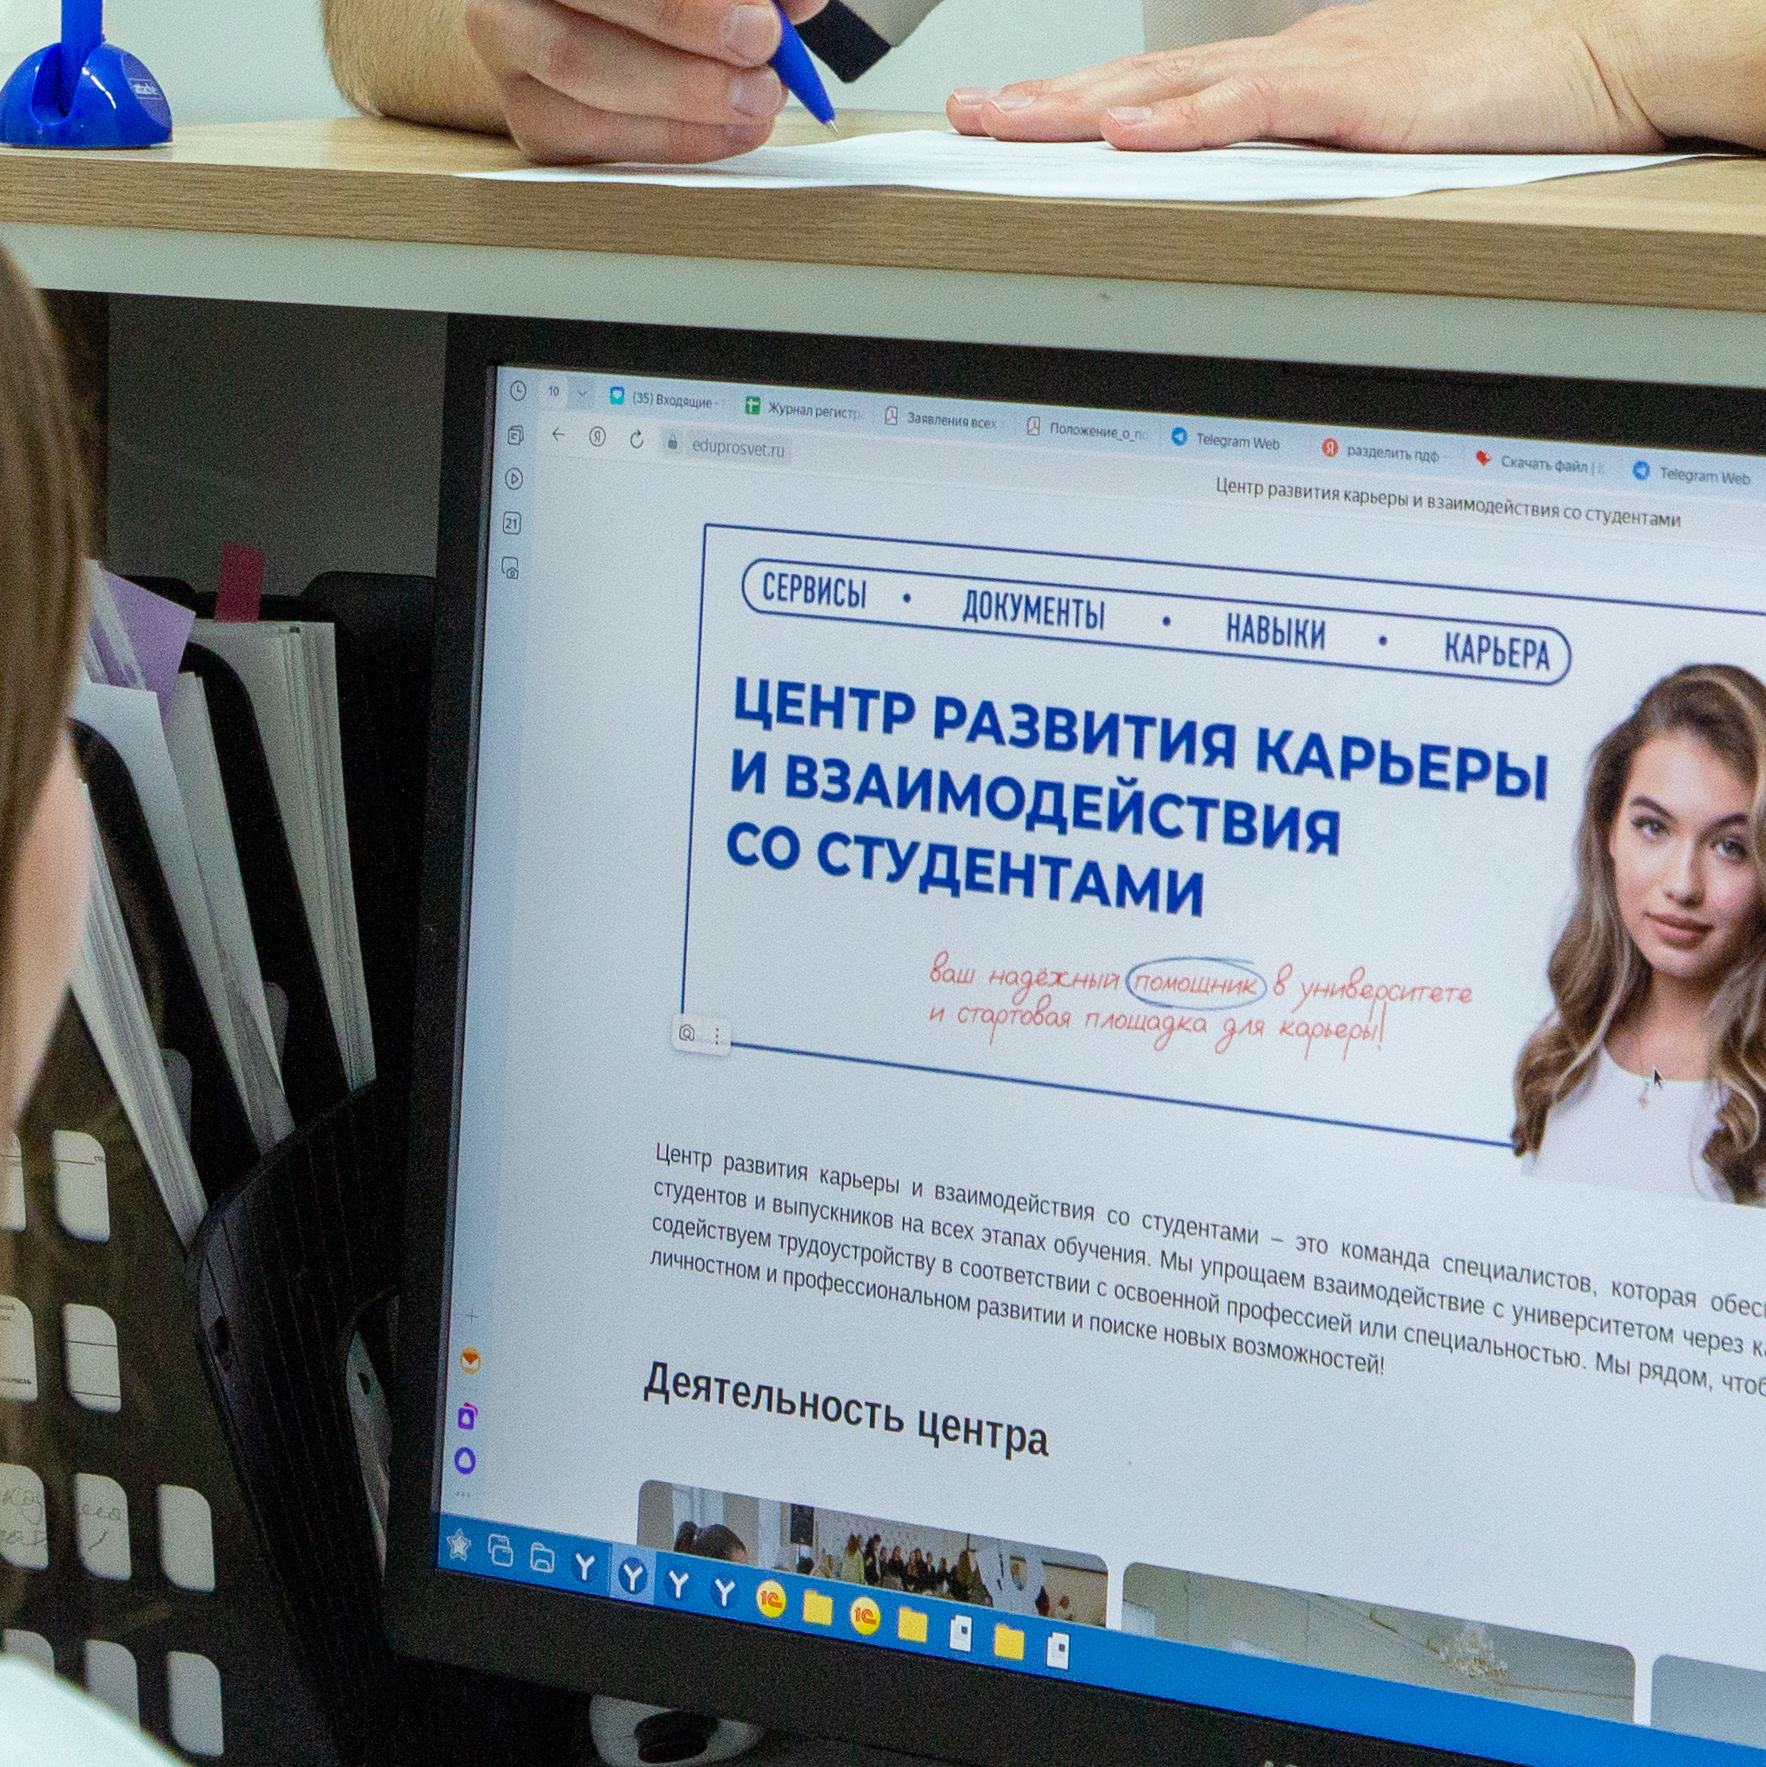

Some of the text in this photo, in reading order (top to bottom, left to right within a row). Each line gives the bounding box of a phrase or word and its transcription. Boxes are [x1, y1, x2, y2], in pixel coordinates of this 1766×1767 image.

[548, 385, 560, 397] 10
[632, 391, 713, 410] (35) Входящие
[768, 401, 817, 419] Журнал
[907, 411, 969, 428] Заявления
[691, 438, 785, 459] eduprosvet.ru
[1195, 431, 1281, 451] Telegram Web
[1346, 443, 1440, 464] разделить пдф
[1499, 454, 1592, 476] Скачать файл
[1659, 466, 1752, 486] Telegram Web
[1216, 476, 1681, 527] Центр развития карьеры и взаимодействия со студентами
[505, 518, 518, 530] 21
[763, 571, 867, 609] СЕРВИСЫ
[962, 589, 1105, 630] ДОКУМЕНТЫ
[1226, 612, 1326, 650] НАВЫКИ
[1445, 632, 1550, 671] КАРЬЕРА
[735, 676, 1548, 801] ЦЕНТР РАЗВИТИЯ КАРЬЕРЫ
[731, 748, 1340, 856] И ВЗАИМОДЕЙСТВИЯ
[727, 821, 1203, 917] СО СТУДЕНТАМИ
[930, 950, 975, 984] ваш
[1133, 972, 1259, 1003] помощник
[1273, 964, 1293, 998] в
[1296, 967, 1472, 1022] университете
[929, 994, 1385, 1061] и стартовая площадка для карьеры!
[656, 1142, 712, 1172] Центр
[723, 1155, 808, 1181] развития
[819, 1168, 900, 1196] карьеры
[912, 1181, 923, 1197] и
[934, 1184, 1095, 1222] взаимодействия
[1107, 1209, 1130, 1226] со
[1141, 1214, 1259, 1245] студентами
[1296, 1235, 1329, 1255] это
[1341, 1242, 1430, 1272] команда
[1442, 1256, 1597, 1297] специалистов,
[1612, 1281, 1697, 1309] которая
[654, 1181, 747, 1208] студентов
[755, 1195, 766, 1211] и
[772, 1197, 893, 1229] выпускников
[901, 1216, 924, 1234] на
[931, 1220, 974, 1241] всех
[981, 1227, 1046, 1251] этапах
[1053, 1235, 1151, 1267] обучения.
[1160, 1249, 1193, 1272] Мы
[1201, 1259, 1305, 1289] упрощаем
[1313, 1275, 1485, 1315] взаимодействие
[1492, 1302, 1504, 1318] с
[1512, 1304, 1674, 1343] университетом
[1683, 1330, 1744, 1355] через
[650, 1250, 1384, 1375] личностном и профессиональном развитии и поиске новых возможностей!
[652, 1216, 771, 1249] содействуем
[778, 1234, 936, 1277] трудоустройству
[942, 1258, 953, 1274] в
[960, 1261, 1090, 1294] соответствии
[1096, 1281, 1107, 1297] с
[1114, 1283, 1220, 1314] освоенной
[1227, 1300, 1352, 1334] профессией
[1359, 1320, 1397, 1340] или
[1403, 1326, 1586, 1369] специальностью.
[1595, 1351, 1631, 1376] Мы
[1638, 1362, 1713, 1391] рядом,
[643, 1361, 1049, 1460] Деятельность центра
